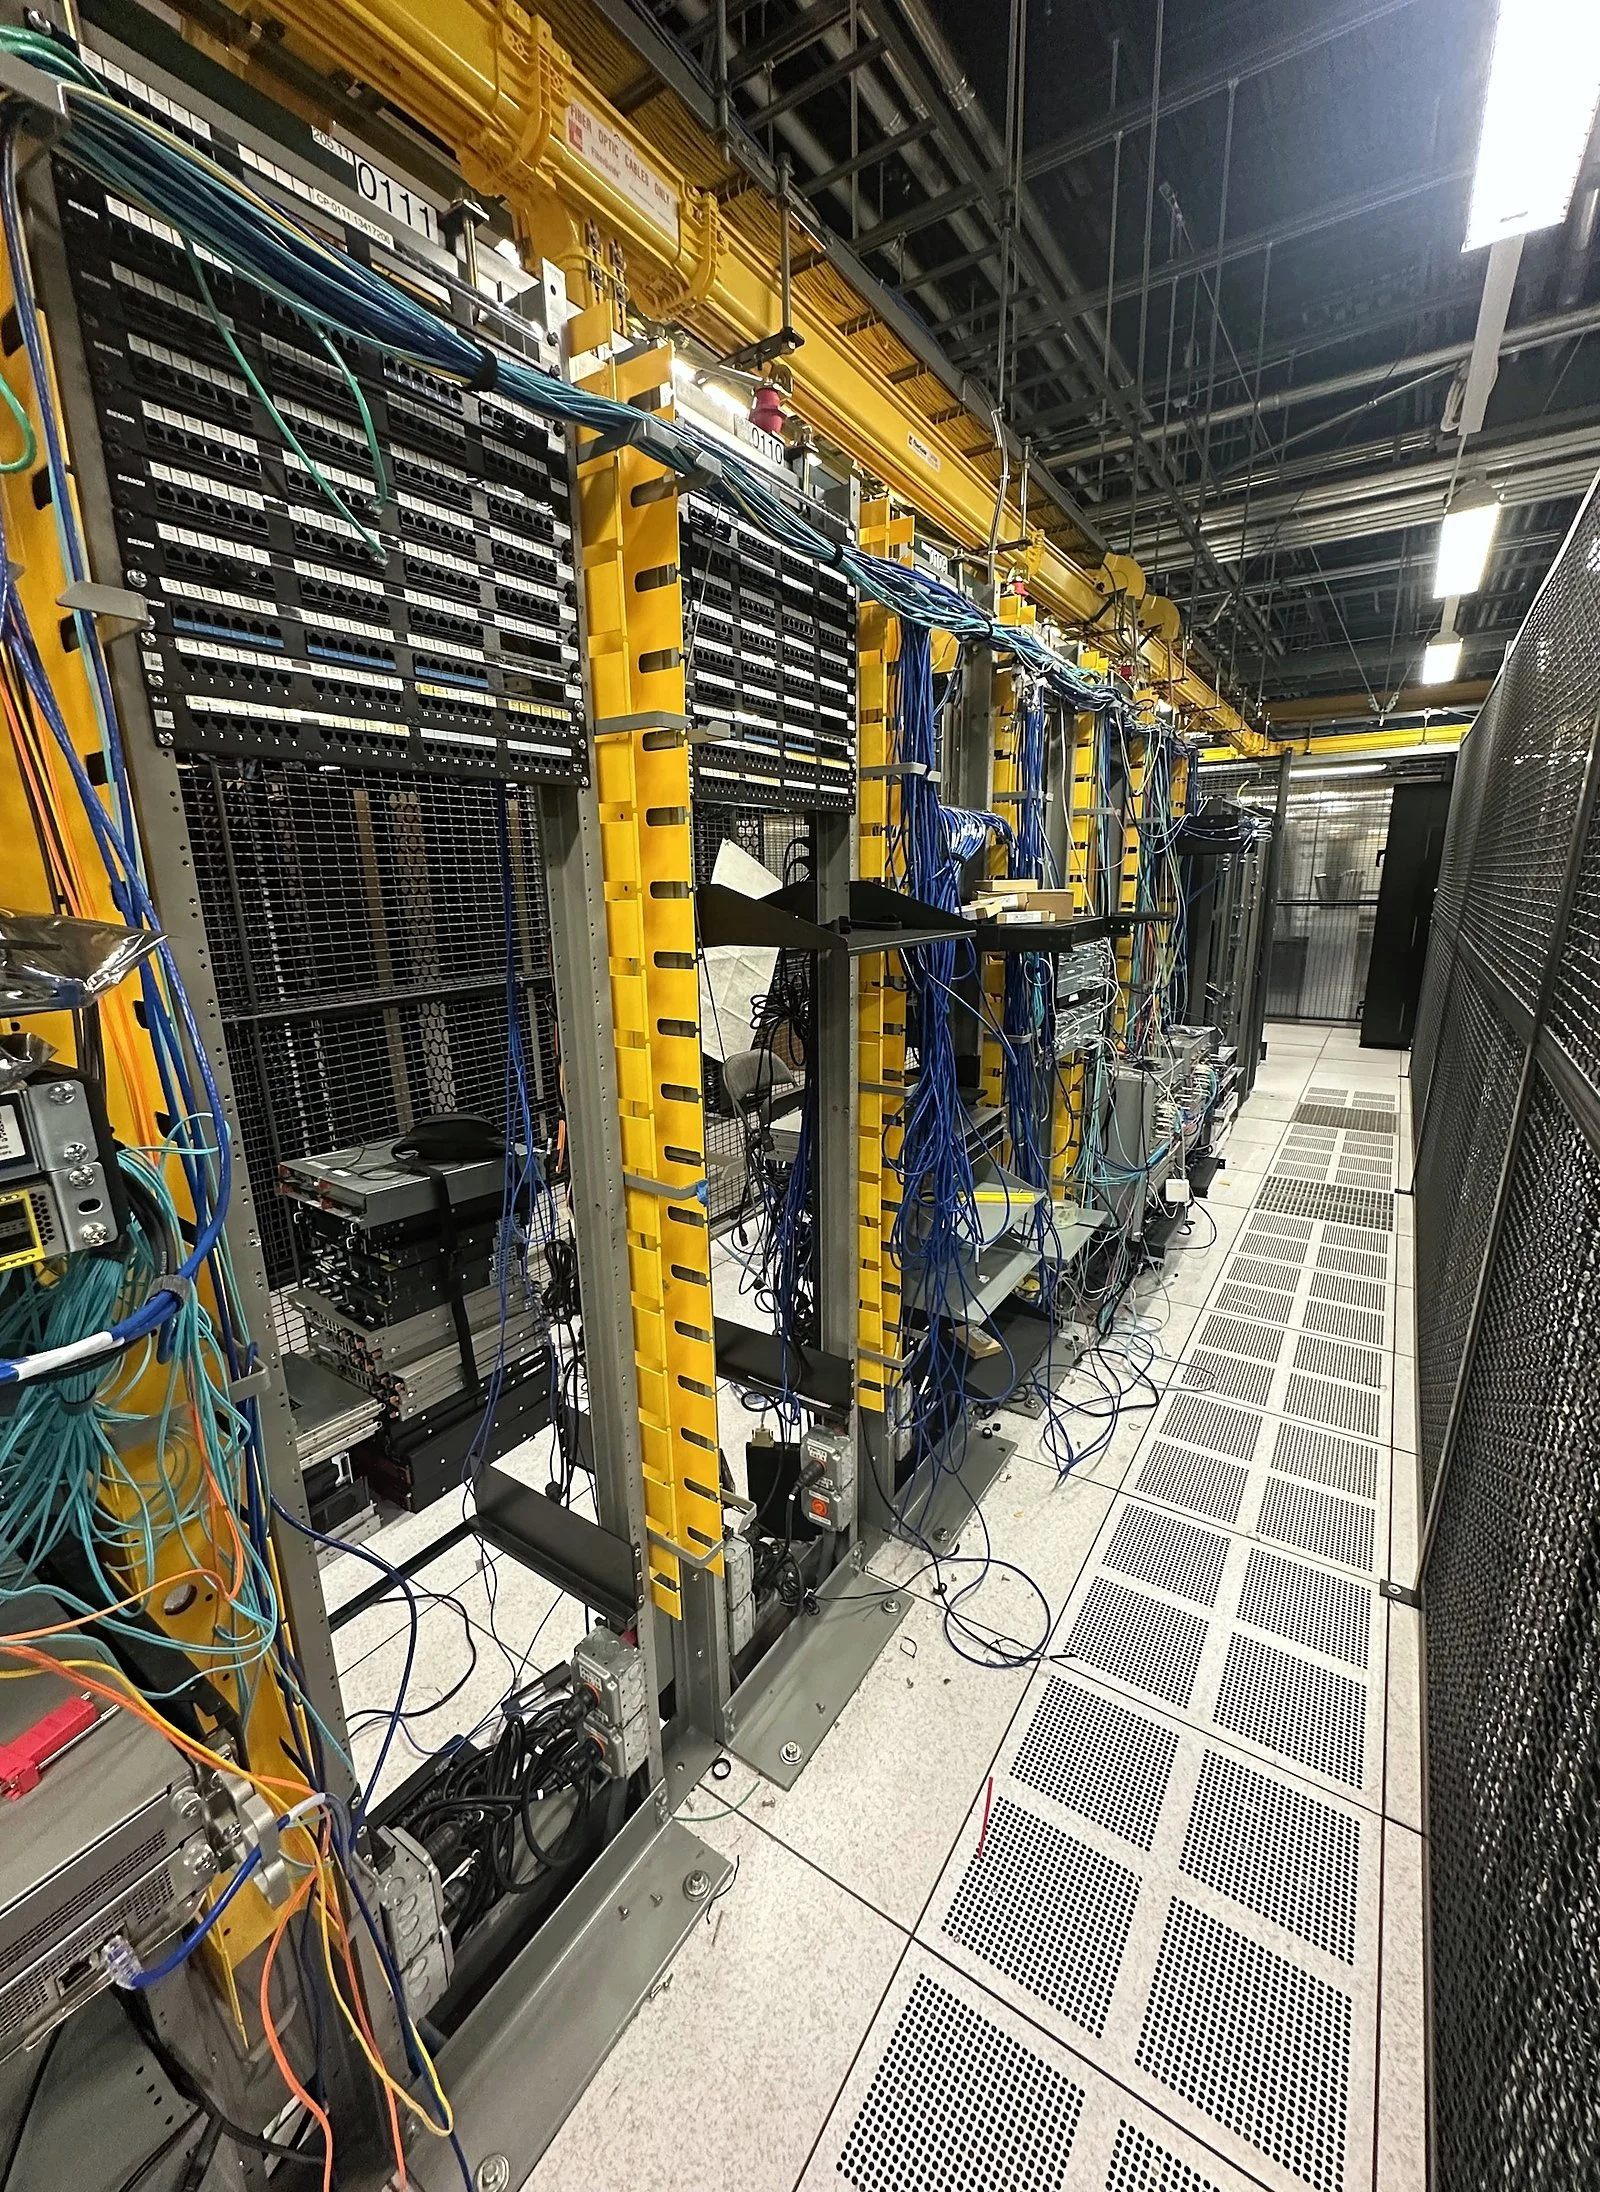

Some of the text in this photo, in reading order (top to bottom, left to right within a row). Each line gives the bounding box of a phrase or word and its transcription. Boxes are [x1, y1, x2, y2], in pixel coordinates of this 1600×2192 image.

[570, 103, 592, 133] FIBER
[598, 129, 619, 158] OPTIC
[624, 154, 649, 186] CABLES
[654, 182, 670, 205] ONLY
[358, 162, 430, 238] 0111
[106, 409, 135, 424] SIEMON
[752, 427, 782, 464] 0110
[117, 473, 146, 487] SIEMON
[127, 537, 155, 549] SIEMON
